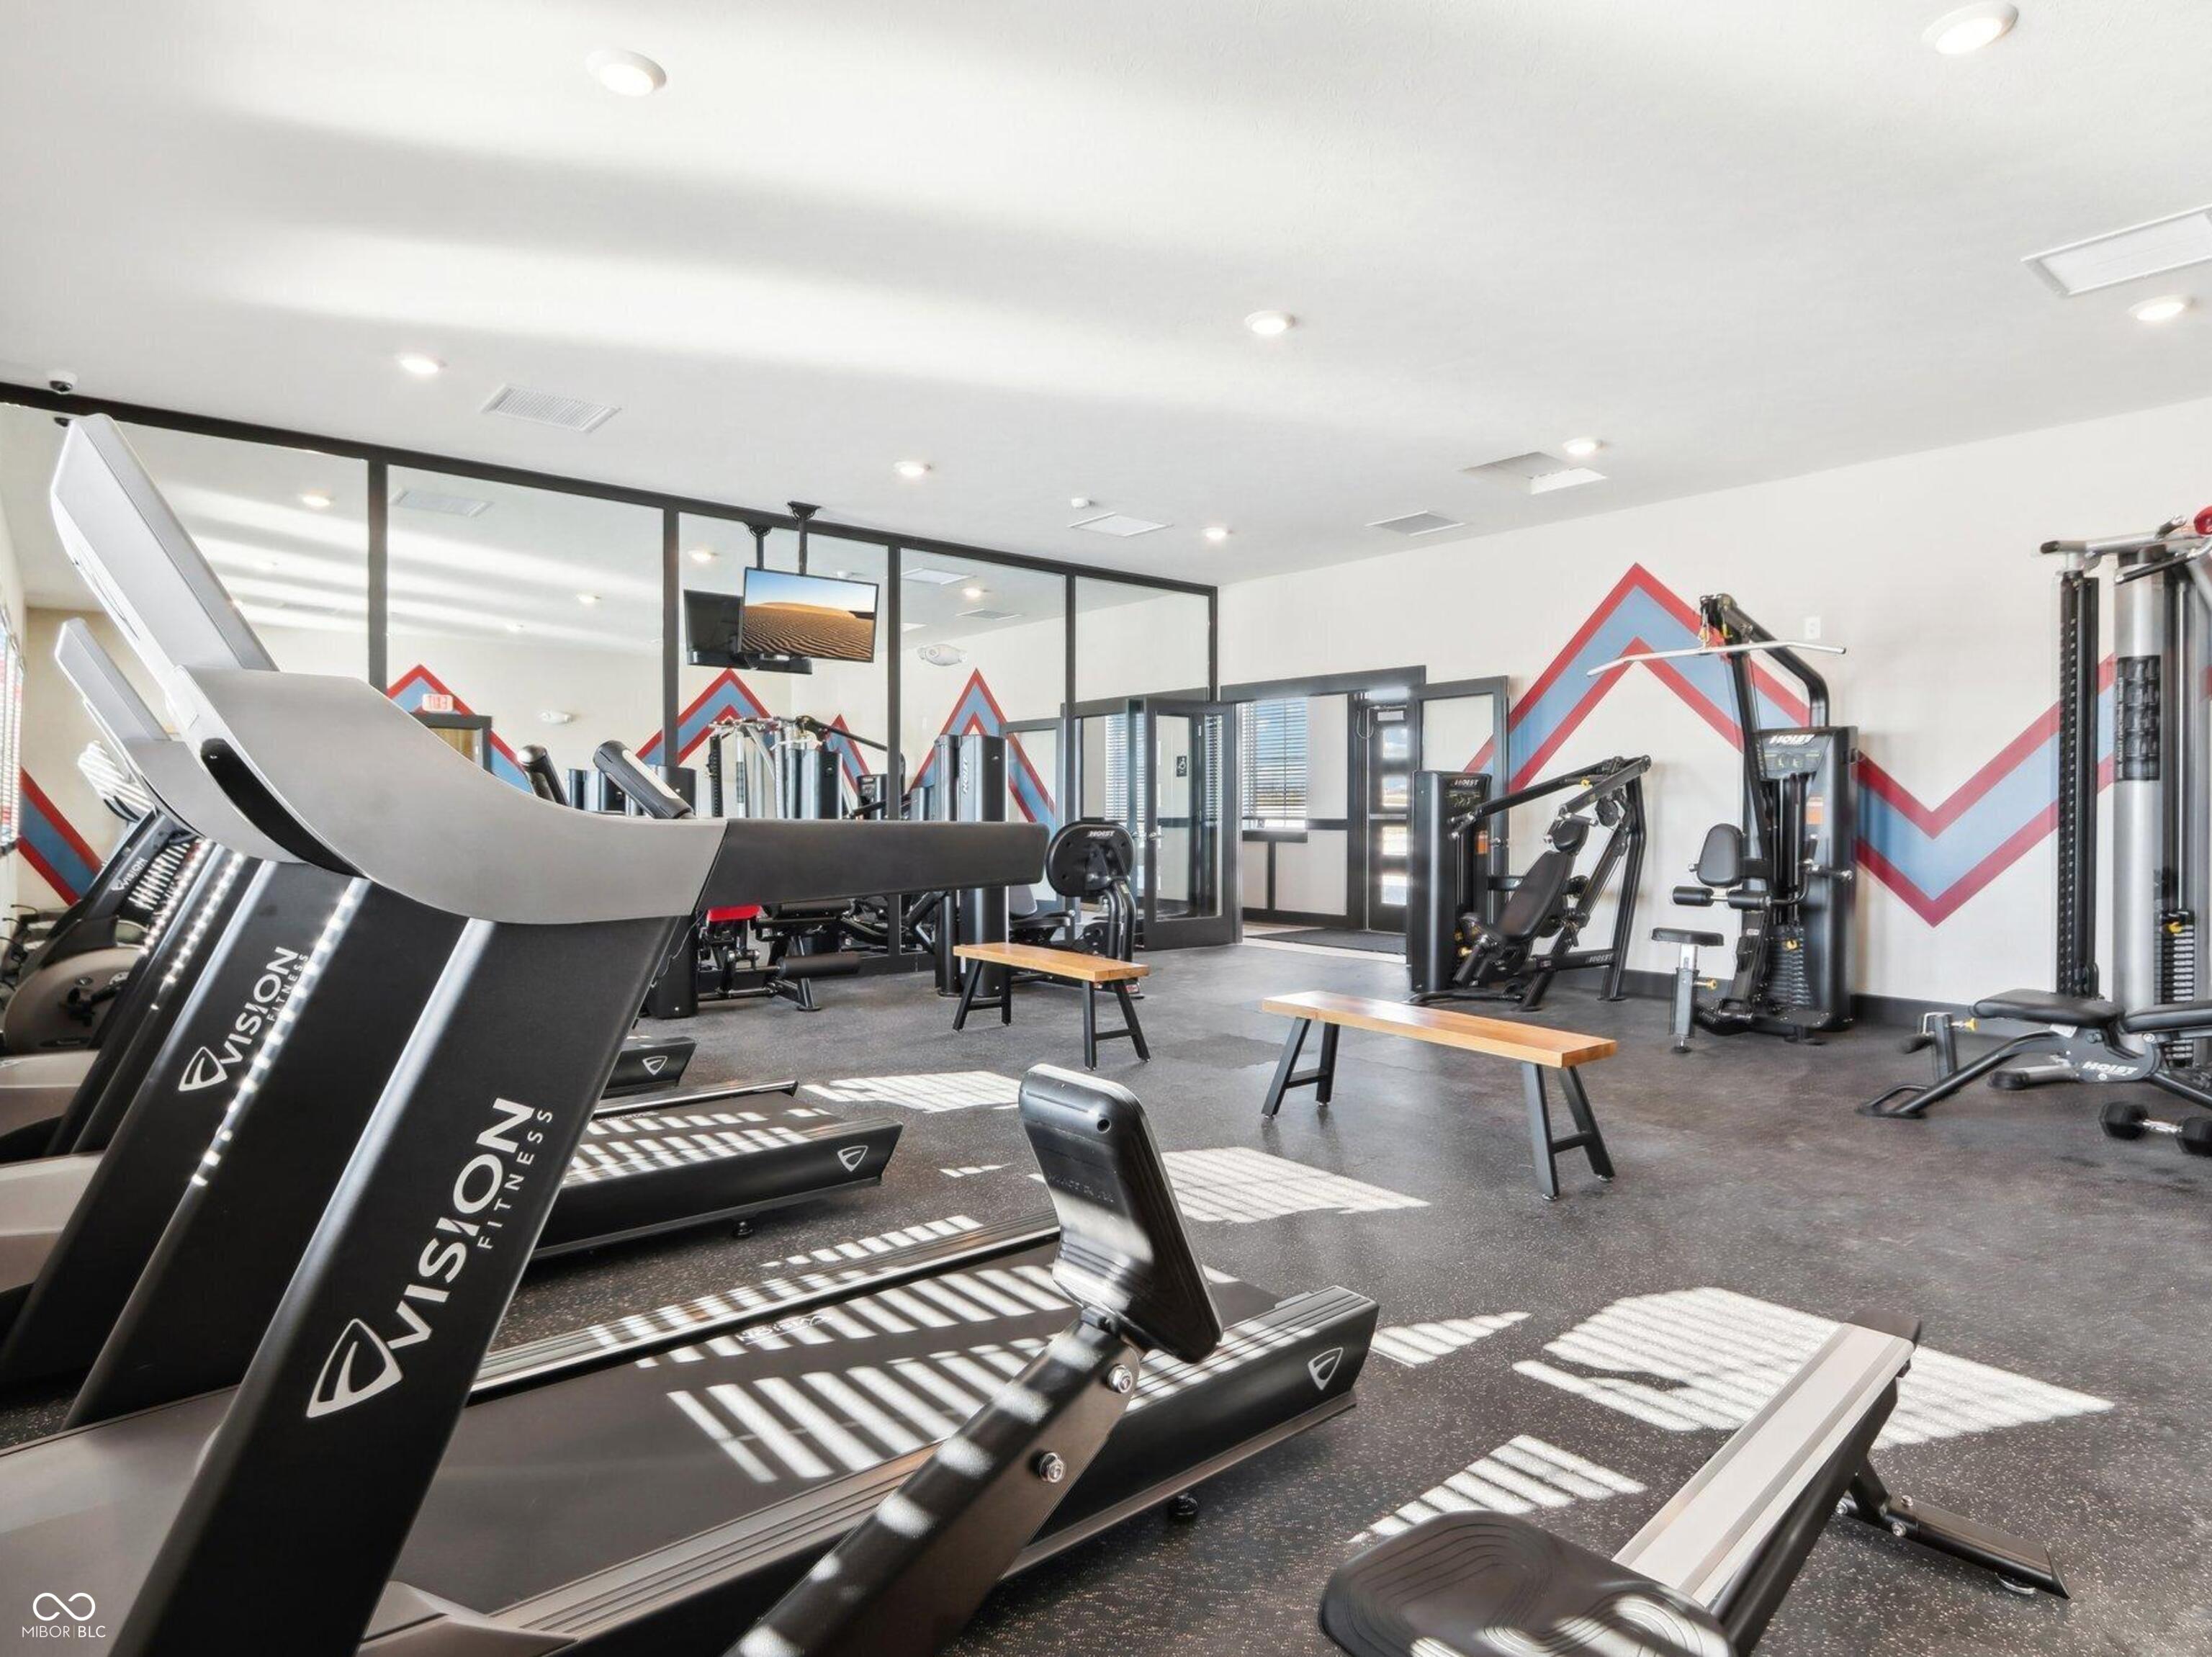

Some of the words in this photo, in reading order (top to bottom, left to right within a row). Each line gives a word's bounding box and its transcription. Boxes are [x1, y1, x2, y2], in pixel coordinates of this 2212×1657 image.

[122, 857, 148, 886] VISION
[220, 946, 300, 1067] VISION
[267, 953, 309, 1022] FITNESS
[2082, 1061, 2139, 1077] HOIST
[387, 1097, 534, 1350] VISION
[477, 1109, 554, 1250] FITNESS
